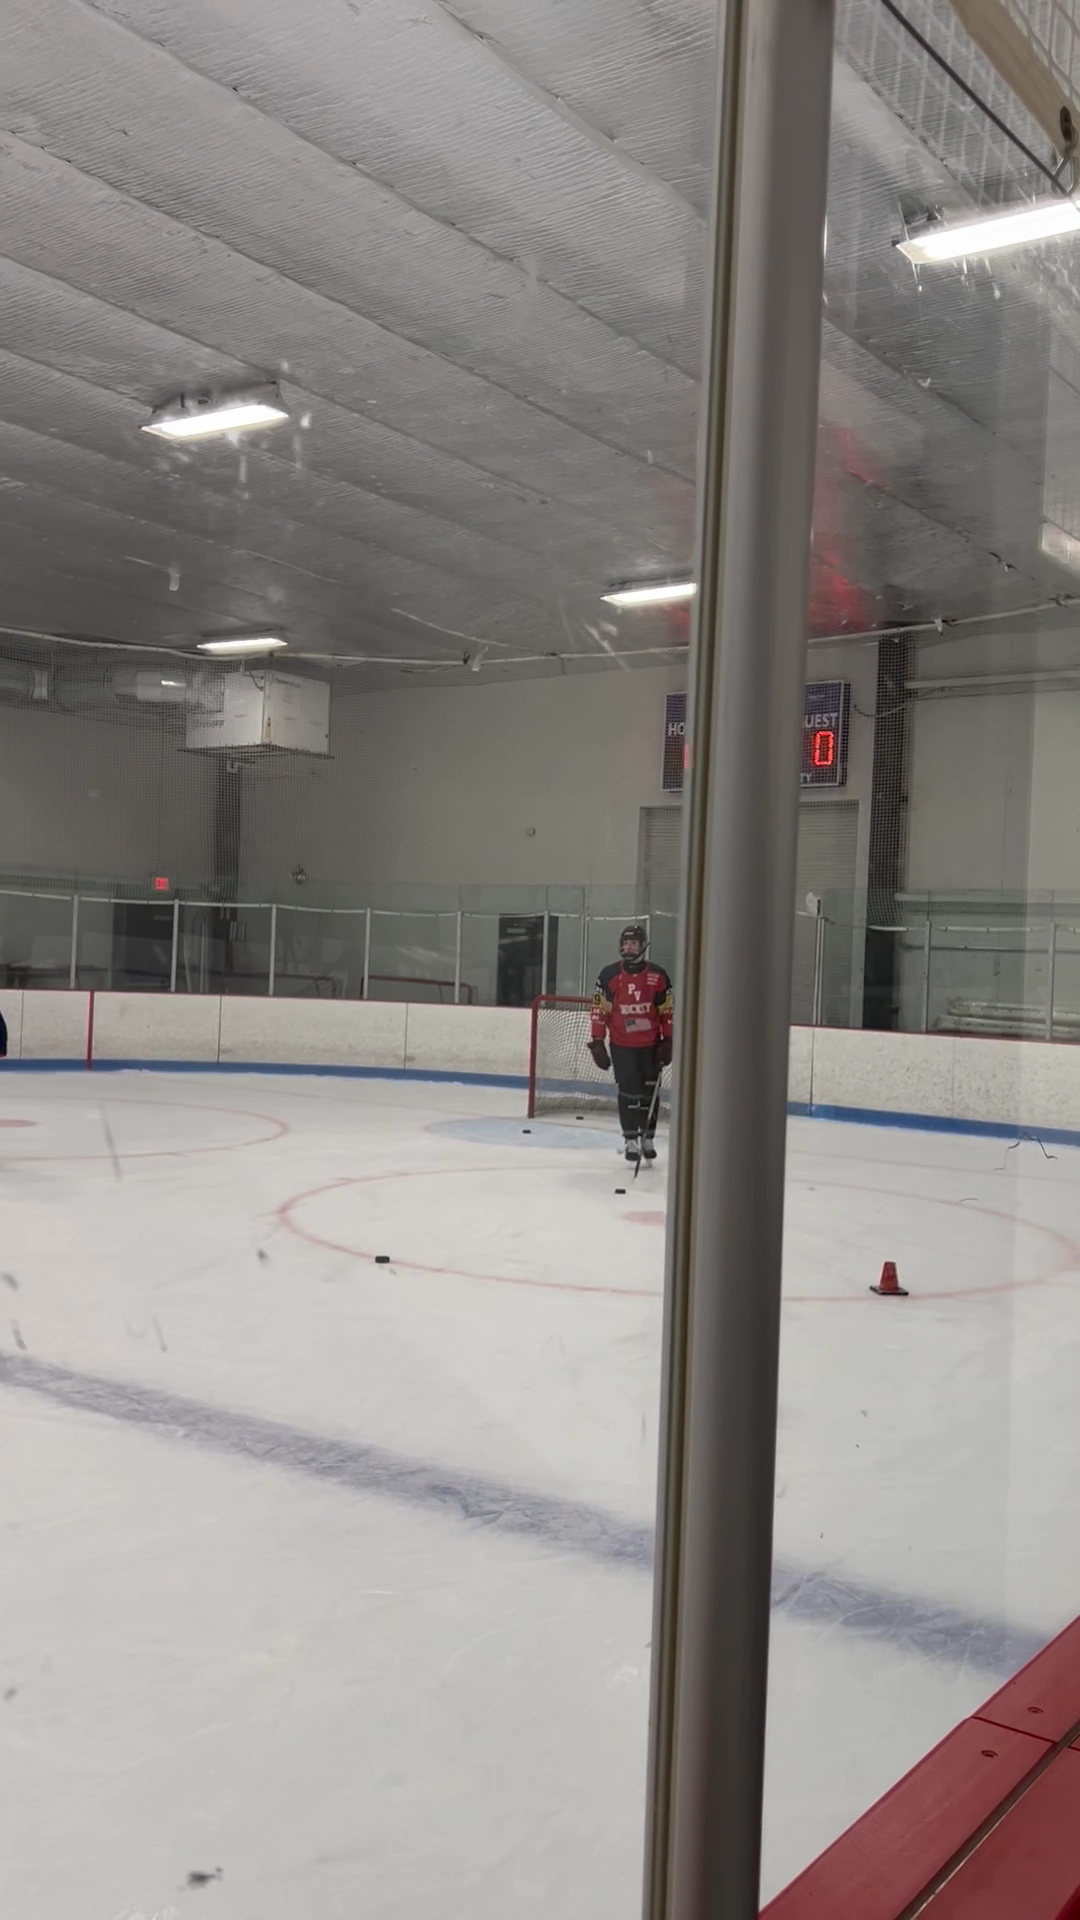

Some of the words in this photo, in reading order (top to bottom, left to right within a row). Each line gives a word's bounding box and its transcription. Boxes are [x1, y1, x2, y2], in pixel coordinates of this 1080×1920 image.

[805, 713, 839, 728] UEST
[668, 722, 685, 736] HO
[814, 731, 834, 765] 0
